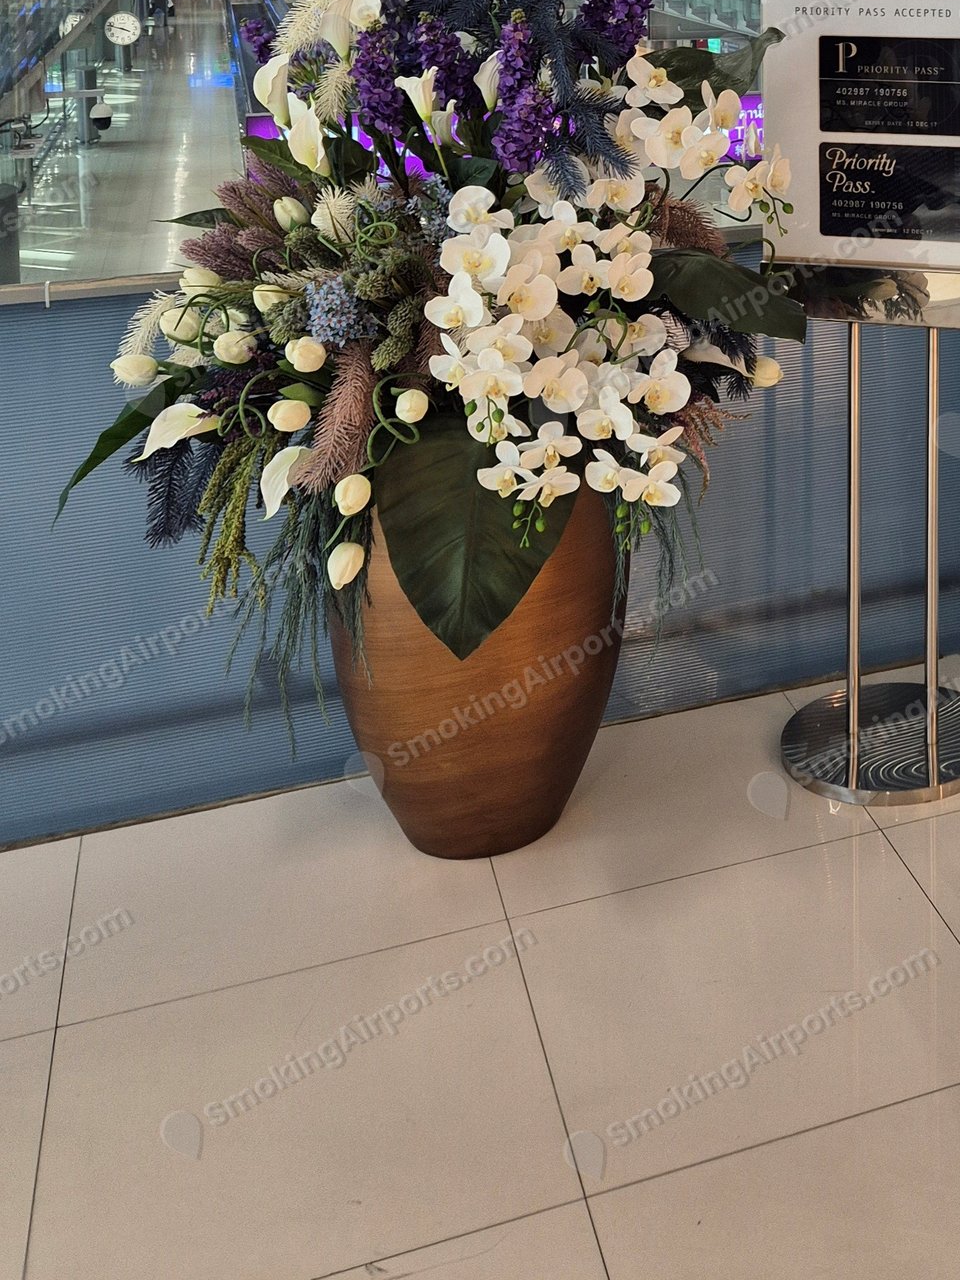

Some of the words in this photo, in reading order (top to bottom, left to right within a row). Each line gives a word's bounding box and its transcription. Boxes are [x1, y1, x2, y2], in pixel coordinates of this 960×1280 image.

[794, 6, 851, 17] PRIORITY
[858, 7, 886, 17] PASS
[894, 7, 952, 18] ACCEPTED
[857, 64, 909, 75] PRIORITY
[836, 87, 870, 96] 402987
[874, 88, 908, 97] 190756
[825, 148, 897, 177] Priority
[832, 200, 866, 209] 402987
